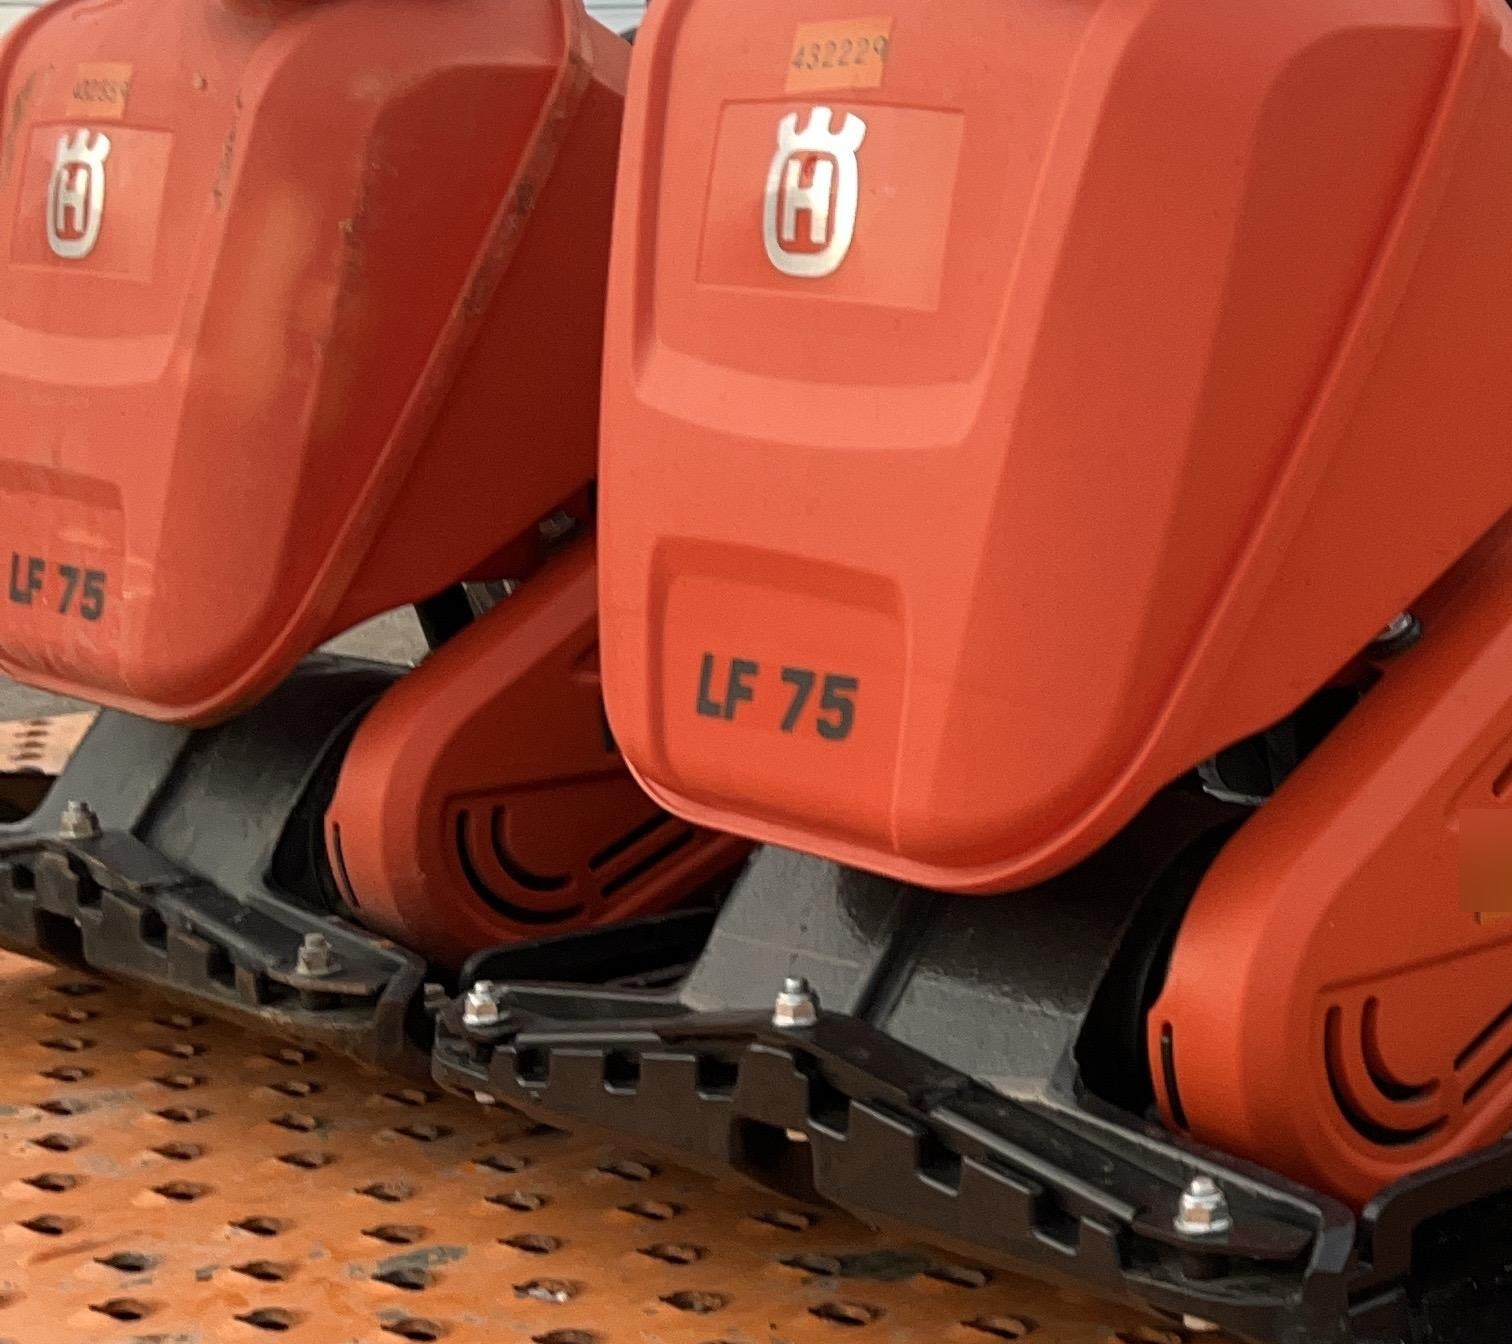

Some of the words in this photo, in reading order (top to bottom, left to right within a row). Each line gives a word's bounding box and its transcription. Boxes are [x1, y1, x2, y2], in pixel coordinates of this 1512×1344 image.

[10, 551, 45, 605] LF
[58, 564, 106, 621] 75
[697, 652, 758, 721] LF
[780, 666, 859, 741] 75
